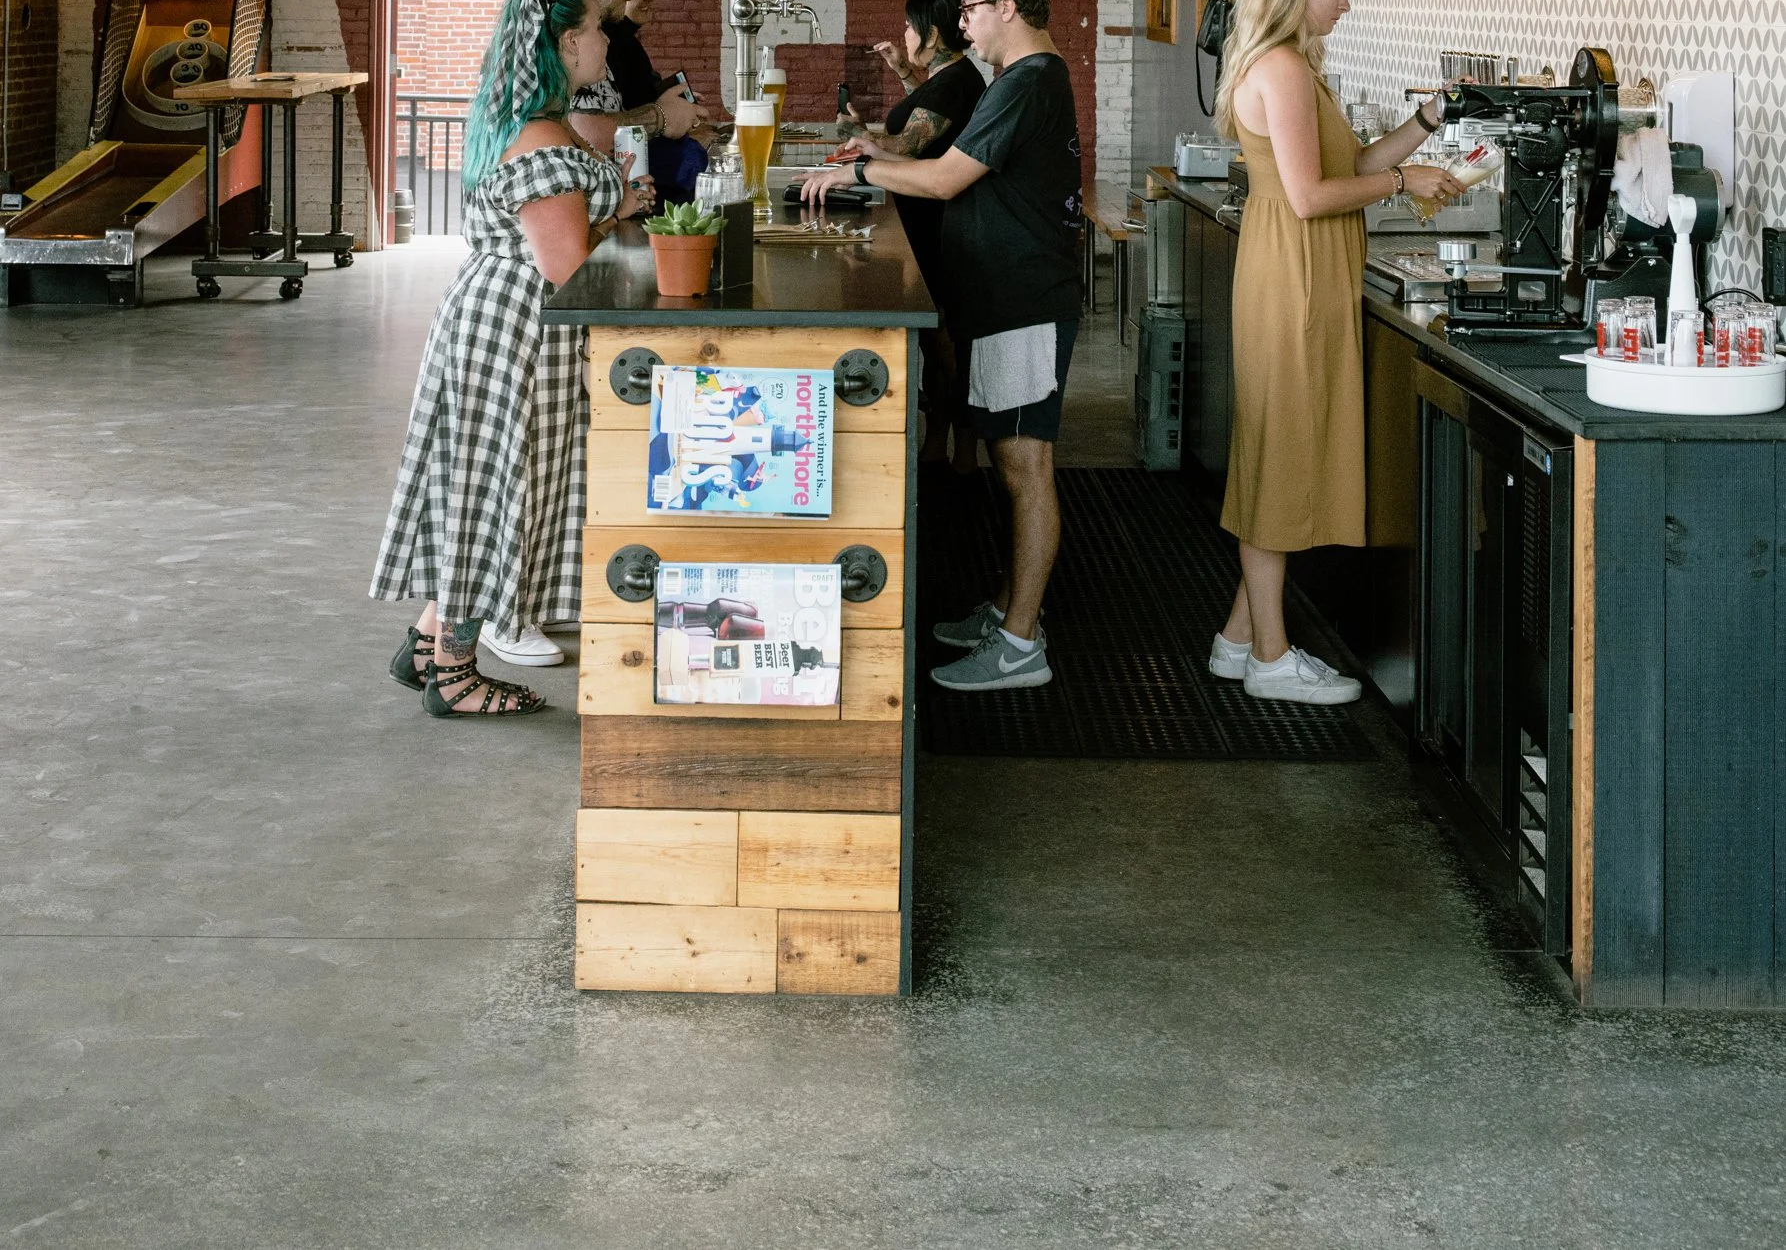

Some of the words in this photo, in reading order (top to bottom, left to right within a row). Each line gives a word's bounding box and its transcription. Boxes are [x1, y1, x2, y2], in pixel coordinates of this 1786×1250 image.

[192, 23, 208, 31] 50
[187, 43, 203, 51] 40
[181, 63, 200, 73] 30
[175, 103, 189, 111] 10
[775, 382, 784, 399] 270
[817, 383, 828, 408] And
[817, 410, 828, 431] the
[816, 433, 826, 477] winner
[816, 478, 827, 498] is...
[753, 643, 763, 669] BEER
[764, 643, 774, 669] BEST
[780, 642, 790, 668] Beer
